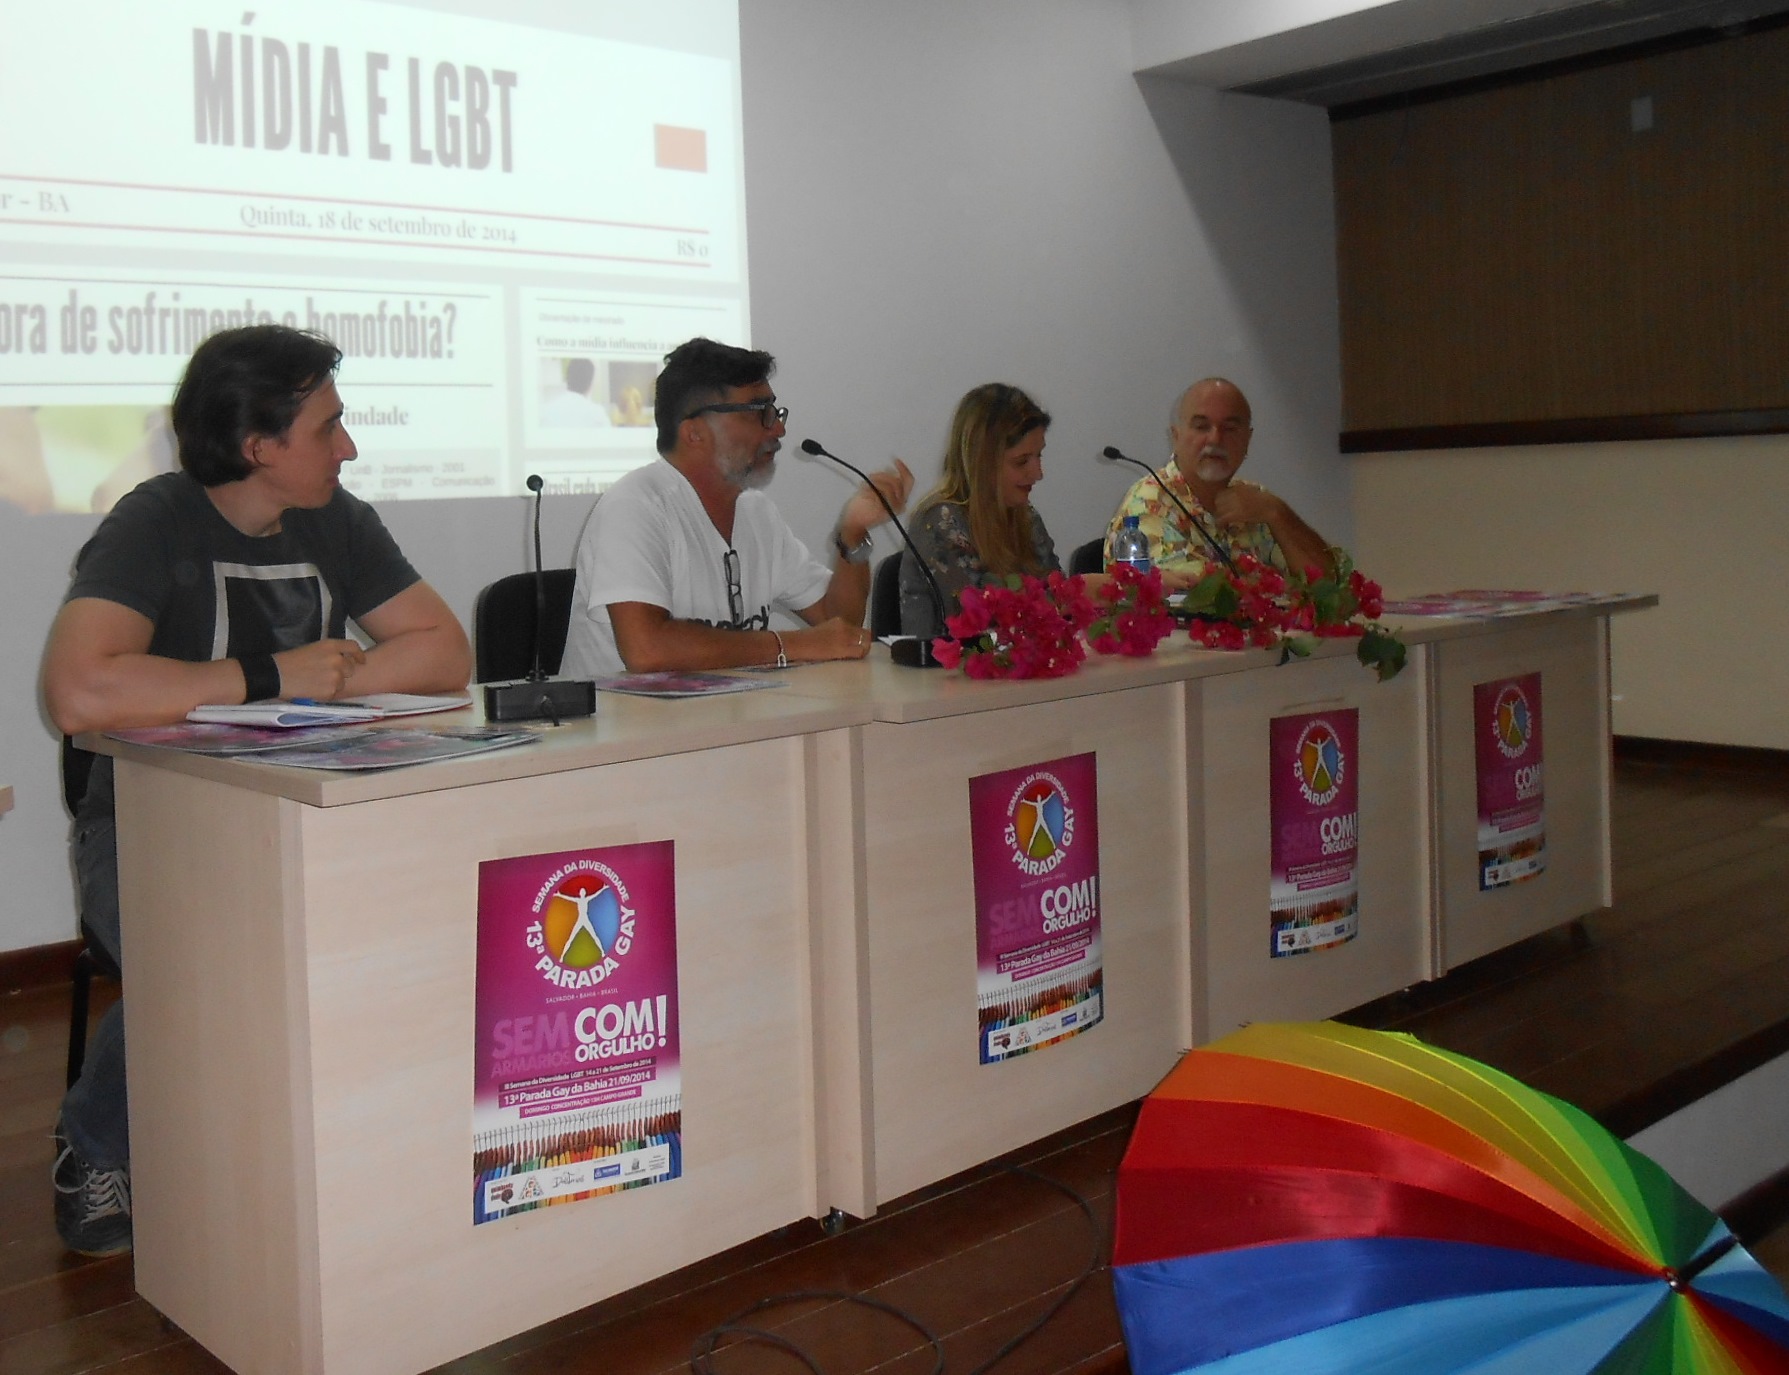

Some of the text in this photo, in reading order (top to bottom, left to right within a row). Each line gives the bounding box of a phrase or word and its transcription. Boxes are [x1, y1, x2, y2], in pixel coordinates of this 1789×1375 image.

[192, 11, 517, 174] MÍDIA E LGBT
[39, 191, 70, 213] BA
[240, 204, 516, 243] Quinta, 18 de setembro de 2014
[60, 288, 97, 355] de
[306, 297, 457, 359] homofobia?
[344, 405, 409, 426] indade
[1299, 782, 1339, 806] PARADA
[1012, 848, 1067, 875] PARADA
[1062, 806, 1075, 847] GAY
[532, 860, 630, 913] SEMANA DA DIVERSIDADE
[1041, 876, 1097, 920] COM!
[1043, 908, 1091, 934] ORGULHO
[535, 955, 620, 989] PARADA
[615, 905, 635, 956] GAY
[1011, 957, 1031, 969] Parada
[1031, 953, 1043, 965] Gay
[546, 988, 618, 1004] SALVADOR BAHIA BRASIL
[492, 1012, 570, 1060] SEM
[574, 995, 667, 1047] COM!
[575, 1033, 655, 1062] ORGULHO
[510, 1080, 531, 1089] Semana
[538, 1074, 570, 1084] Diversidade
[570, 1070, 585, 1079] LGBT
[639, 1058, 652, 1066] 2014
[520, 1088, 551, 1102] Parada
[552, 1086, 571, 1098] Gay
[571, 1083, 583, 1093] da
[584, 1078, 607, 1092] Bahia
[608, 1071, 651, 1087] 21/09/2014
[525, 1104, 550, 1114] DOMINGO
